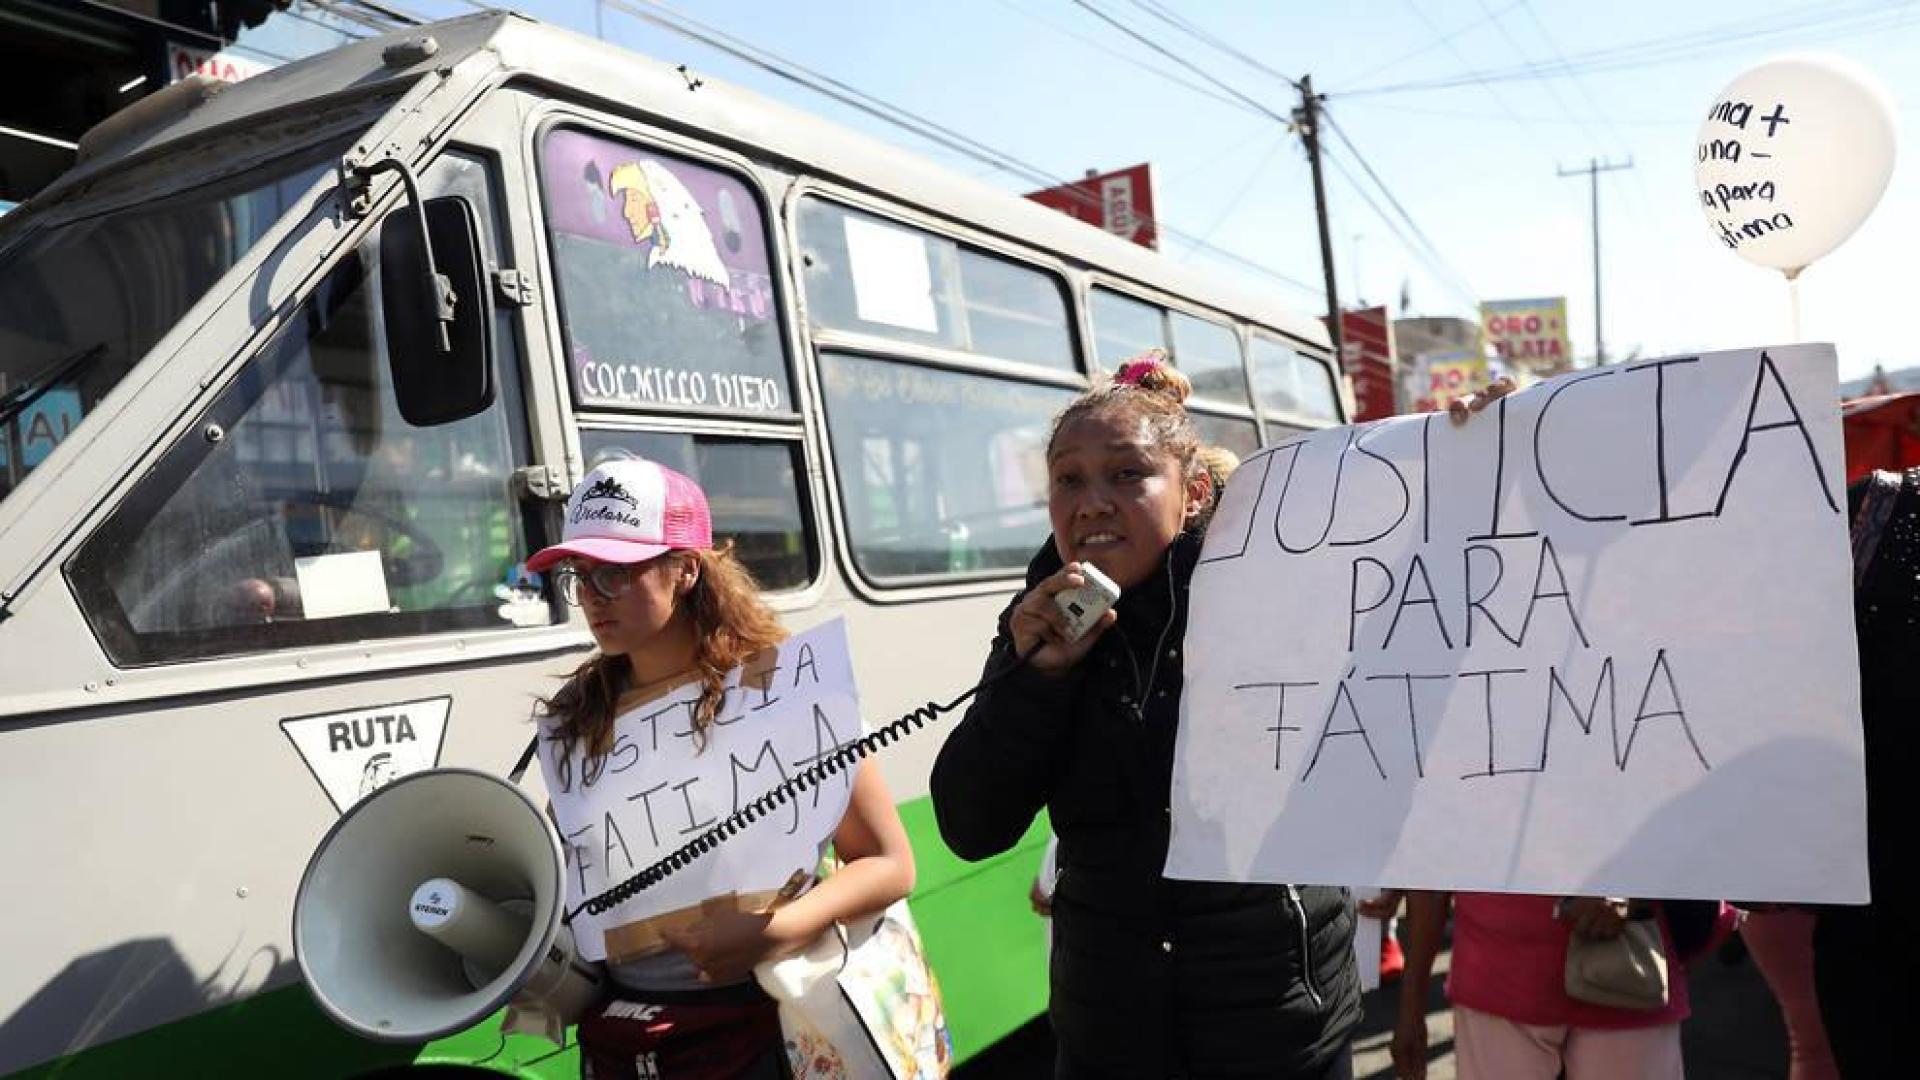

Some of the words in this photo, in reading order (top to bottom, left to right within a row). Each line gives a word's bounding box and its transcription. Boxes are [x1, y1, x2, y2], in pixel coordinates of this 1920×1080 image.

[582, 360, 707, 404] COLMILLO
[1200, 351, 1841, 564] JUSTICIA
[1347, 535, 1590, 651] PARA
[327, 713, 417, 753] RUTA
[1234, 649, 1711, 782] FÁTIMA
